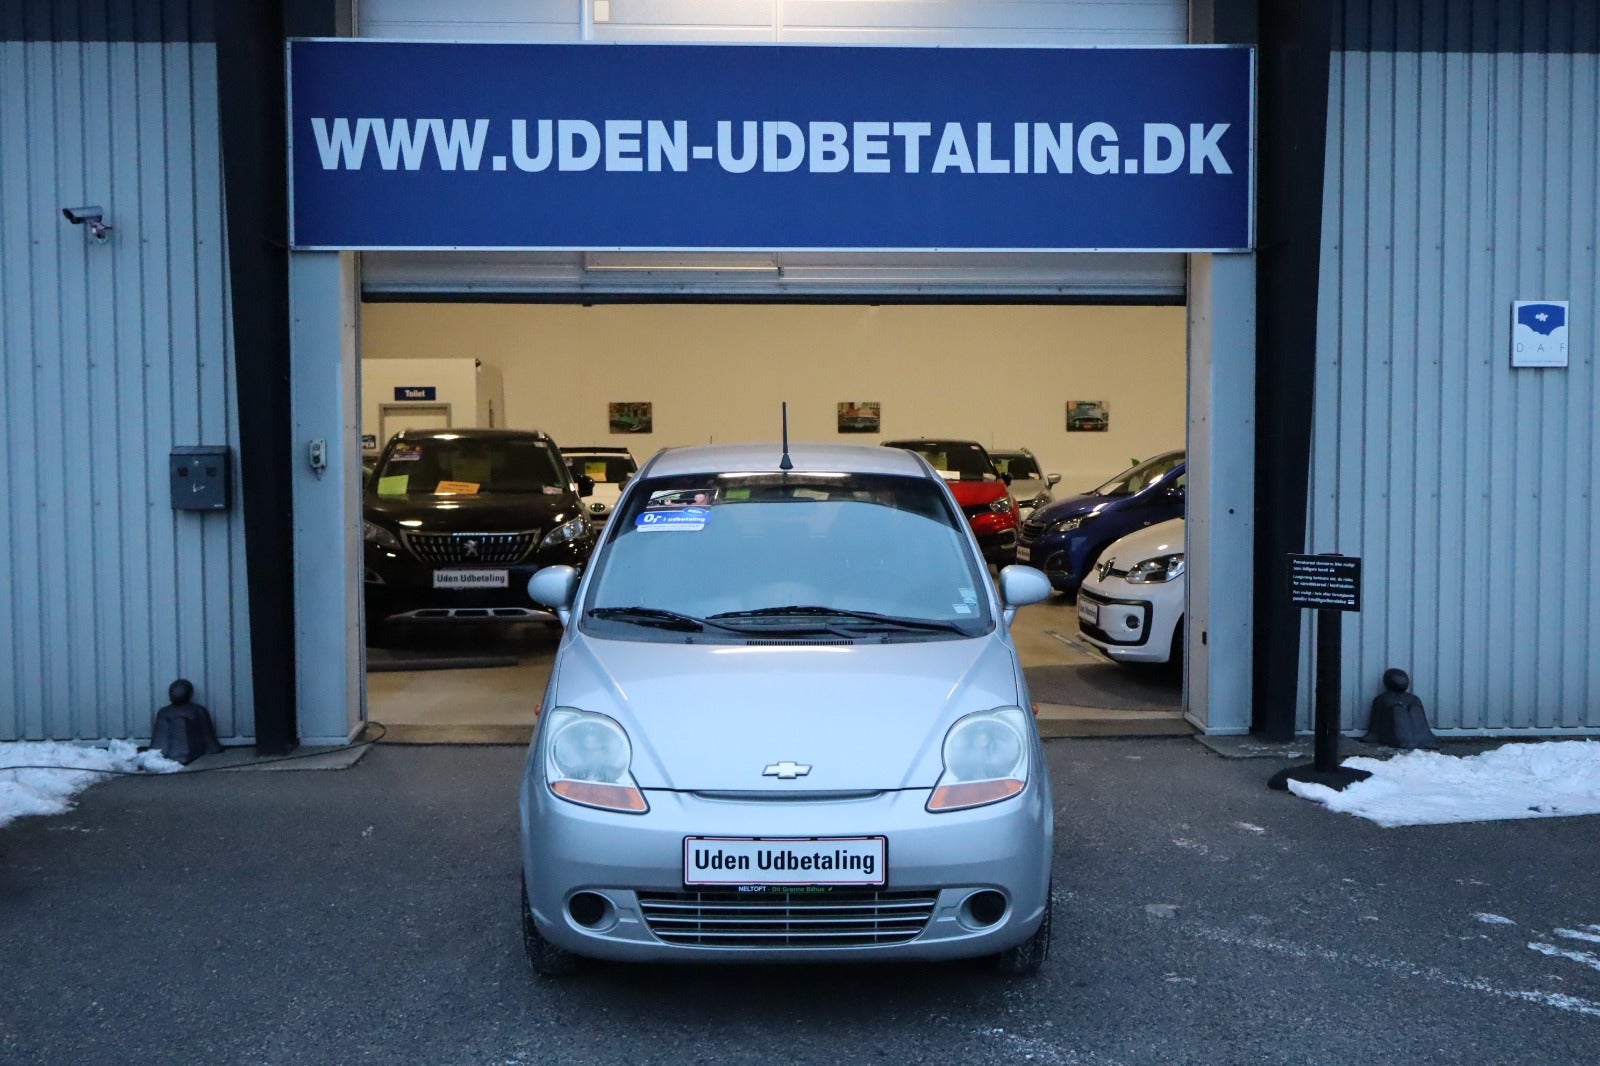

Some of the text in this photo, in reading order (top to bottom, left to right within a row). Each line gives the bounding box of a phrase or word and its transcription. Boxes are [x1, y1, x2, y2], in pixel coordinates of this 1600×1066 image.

[310, 117, 1233, 176] WWW.UDEN-UDBETALING.DK
[405, 389, 426, 398] Toilet
[436, 573, 506, 585] Uden Udbetaling
[694, 849, 875, 875] Uden Udbetaling
[738, 885, 767, 893] NELTOFT
